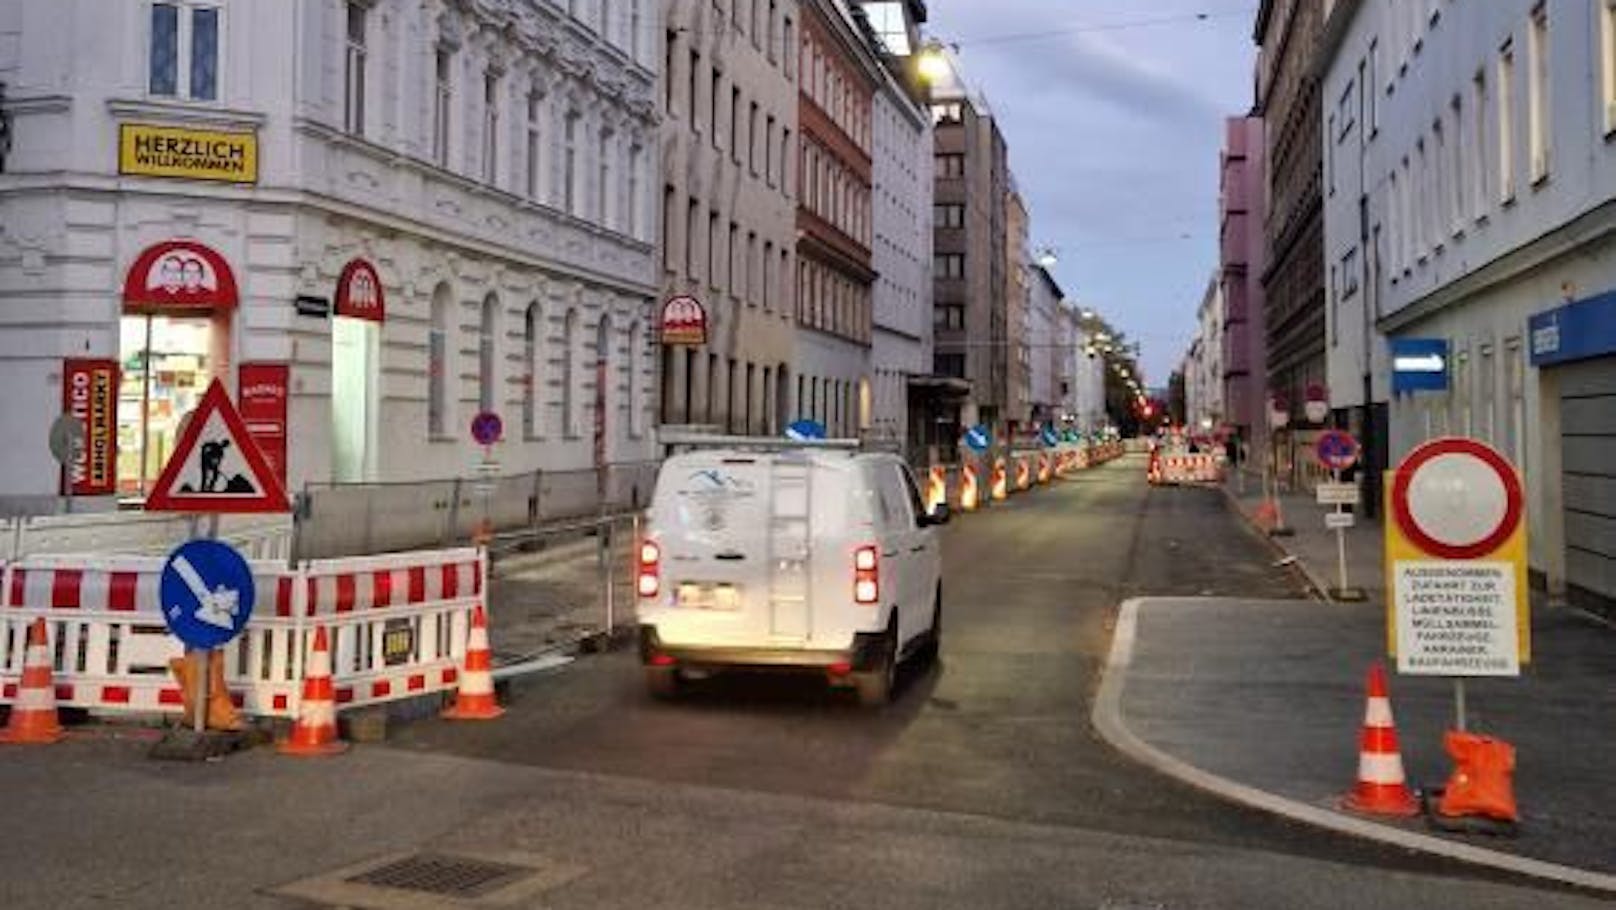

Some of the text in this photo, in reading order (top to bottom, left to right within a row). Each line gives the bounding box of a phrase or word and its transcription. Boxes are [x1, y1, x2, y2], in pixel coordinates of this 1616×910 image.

[134, 134, 246, 159] HERZLICH
[136, 153, 245, 173] WILLKOMMEN
[94, 373, 107, 481] ABHOLMARKT
[1411, 580, 1497, 592] ZUFAHRT ZUR
